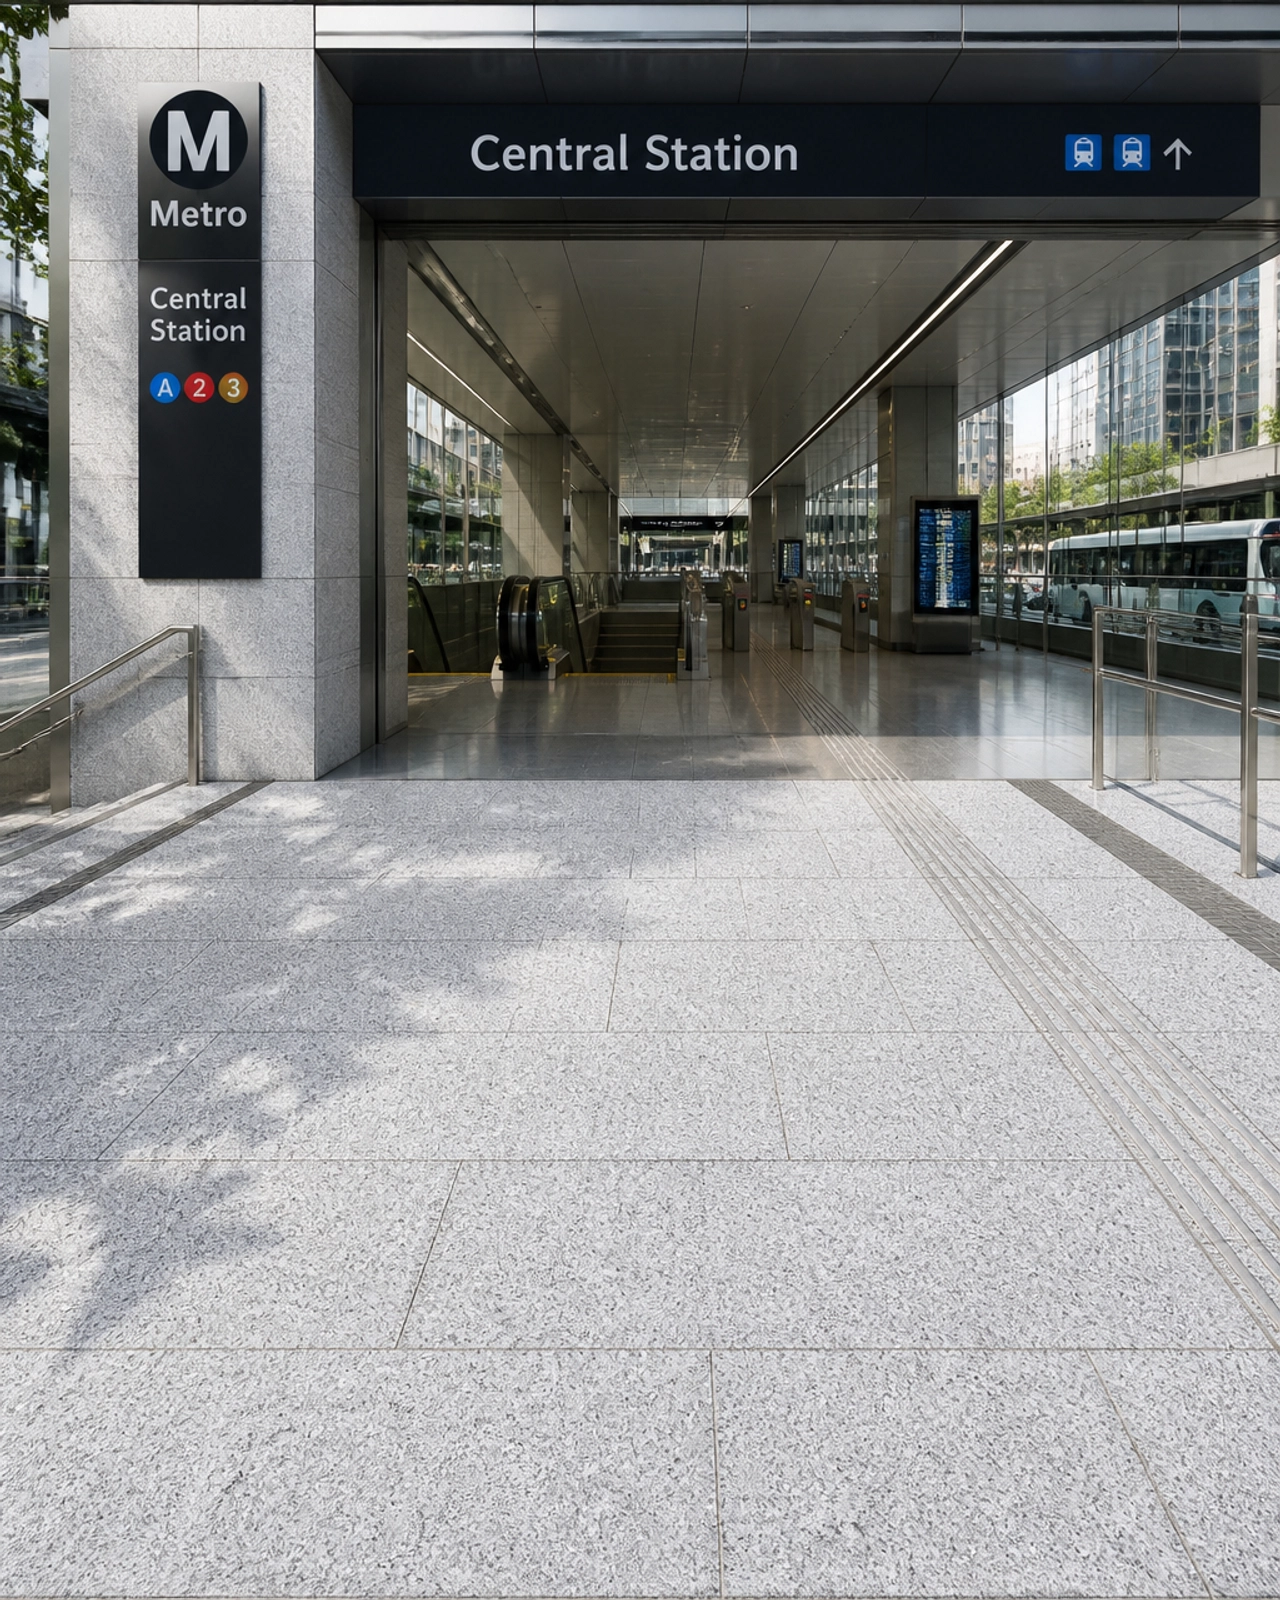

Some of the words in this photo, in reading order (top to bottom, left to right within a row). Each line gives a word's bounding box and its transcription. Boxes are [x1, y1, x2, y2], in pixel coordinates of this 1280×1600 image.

[167, 110, 230, 172] M
[470, 133, 628, 172] Central
[645, 133, 798, 172] Station
[150, 200, 247, 228] Metro
[150, 286, 246, 310] Central
[150, 318, 246, 342] Station
[157, 379, 174, 397] A
[193, 378, 206, 398] 2
[227, 378, 241, 398] 3
